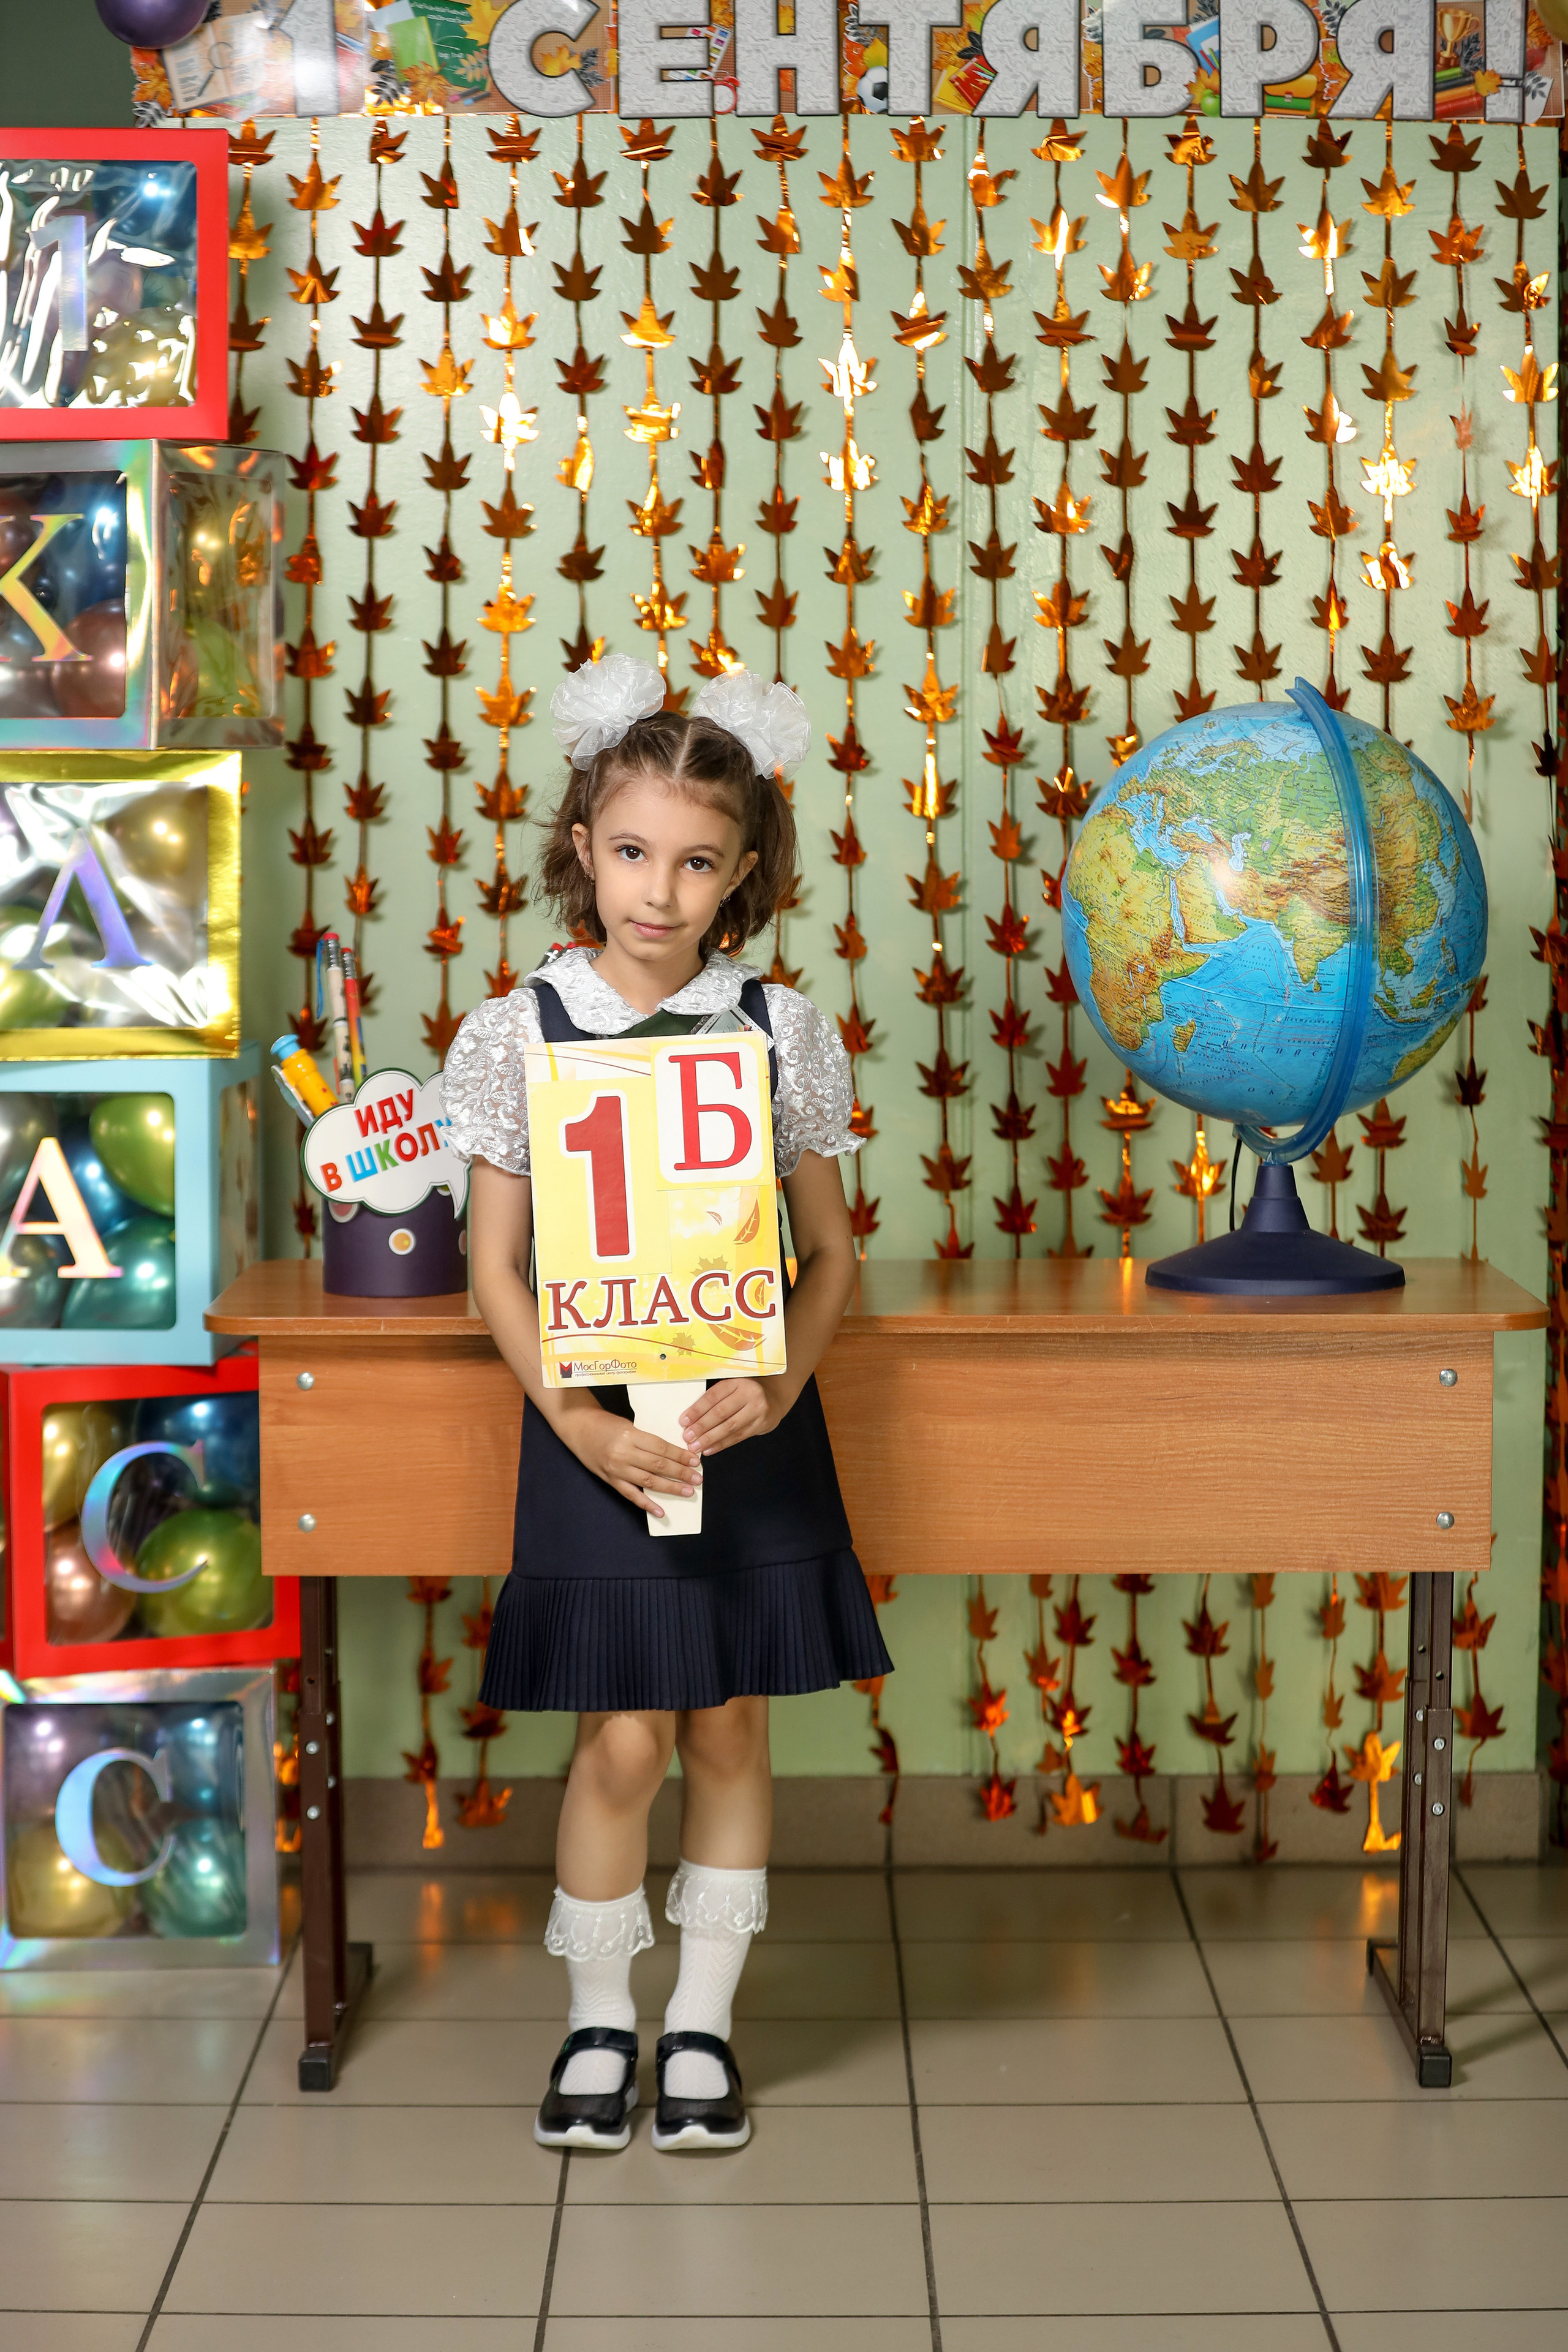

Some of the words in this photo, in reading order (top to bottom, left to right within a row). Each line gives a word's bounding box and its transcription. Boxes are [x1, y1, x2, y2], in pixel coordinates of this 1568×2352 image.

[279, 0, 339, 118] 1
[489, 0, 1526, 120] СЕНТЯБРЯ!
[28, 215, 88, 352] 1
[355, 1088, 415, 1137] ИДУ
[565, 1095, 630, 1257] 1
[668, 1051, 753, 1171] Б
[0, 1137, 123, 1279] А
[320, 1161, 342, 1193] В
[545, 1270, 776, 1330] КЛАСС
[573, 1359, 637, 1371] МосГорФото
[81, 1439, 208, 1594] С
[55, 1746, 175, 1887] С
